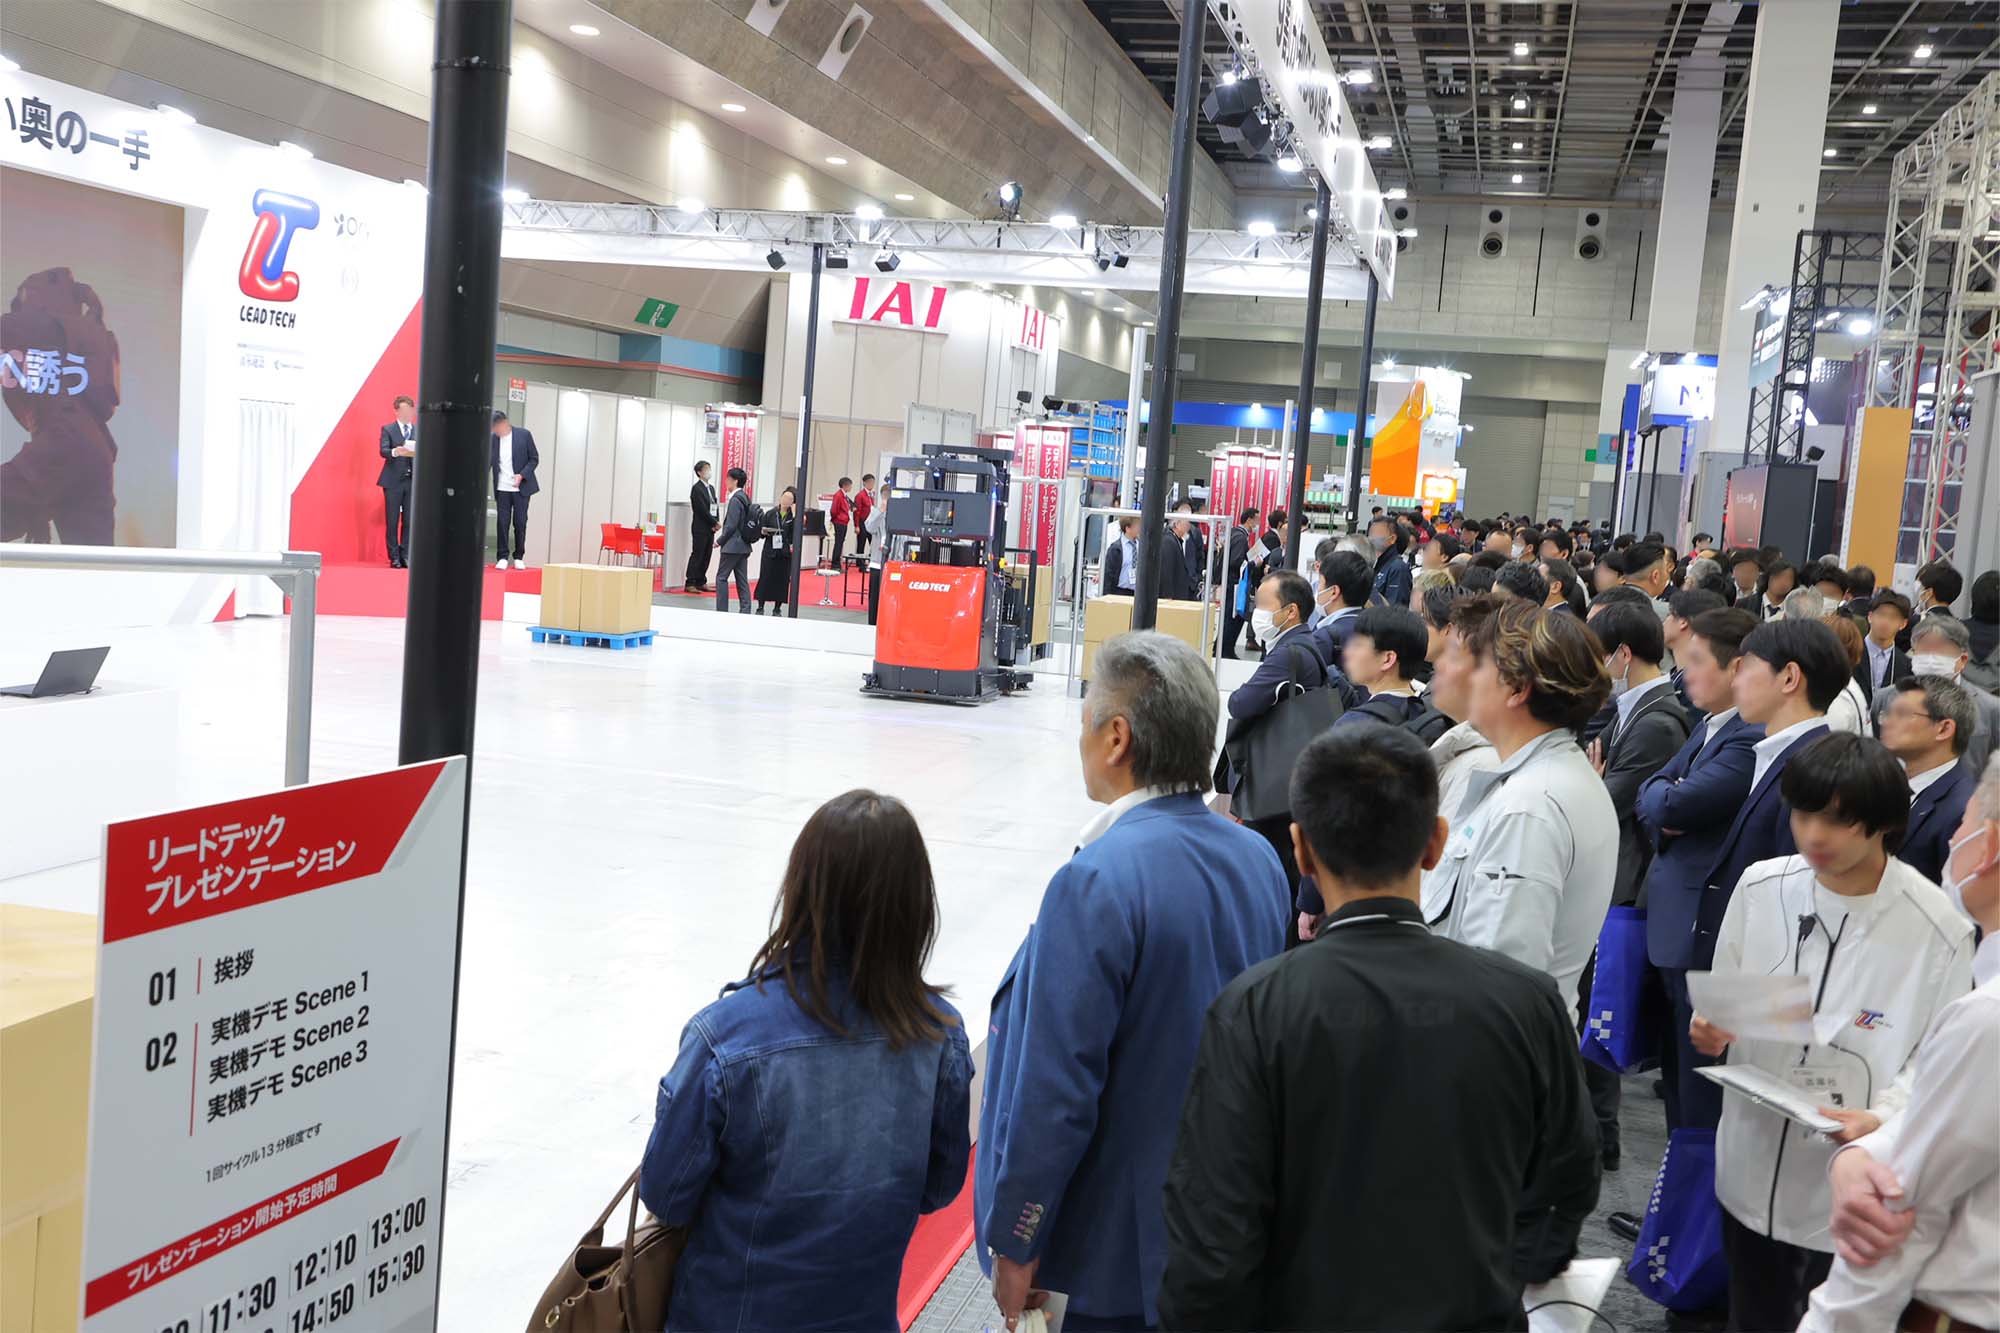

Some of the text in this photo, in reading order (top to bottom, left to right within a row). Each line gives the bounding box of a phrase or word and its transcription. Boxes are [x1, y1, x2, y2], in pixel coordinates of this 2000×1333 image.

[239, 305, 297, 328] LEAD TECH
[848, 277, 948, 329] IAI
[1021, 304, 1049, 351] IAI
[0, 348, 89, 396] へ誘う
[908, 581, 951, 592] LEAD TECH
[147, 813, 286, 874] リードテック
[145, 839, 357, 916] プレゼンテーション
[148, 948, 254, 1007] 01 挨拶
[210, 970, 369, 1046] 実機デモ Scene 1
[145, 1031, 178, 1073] 02
[208, 1005, 370, 1084] 実機デモ Scene 2
[207, 1039, 368, 1123] 実機デモ Scene 3
[127, 1172, 338, 1290] プレゼンテーション開始予定時間
[209, 1197, 427, 1333] 11:30 12:10 13:00
[291, 1244, 425, 1333] 14:50 15:30
